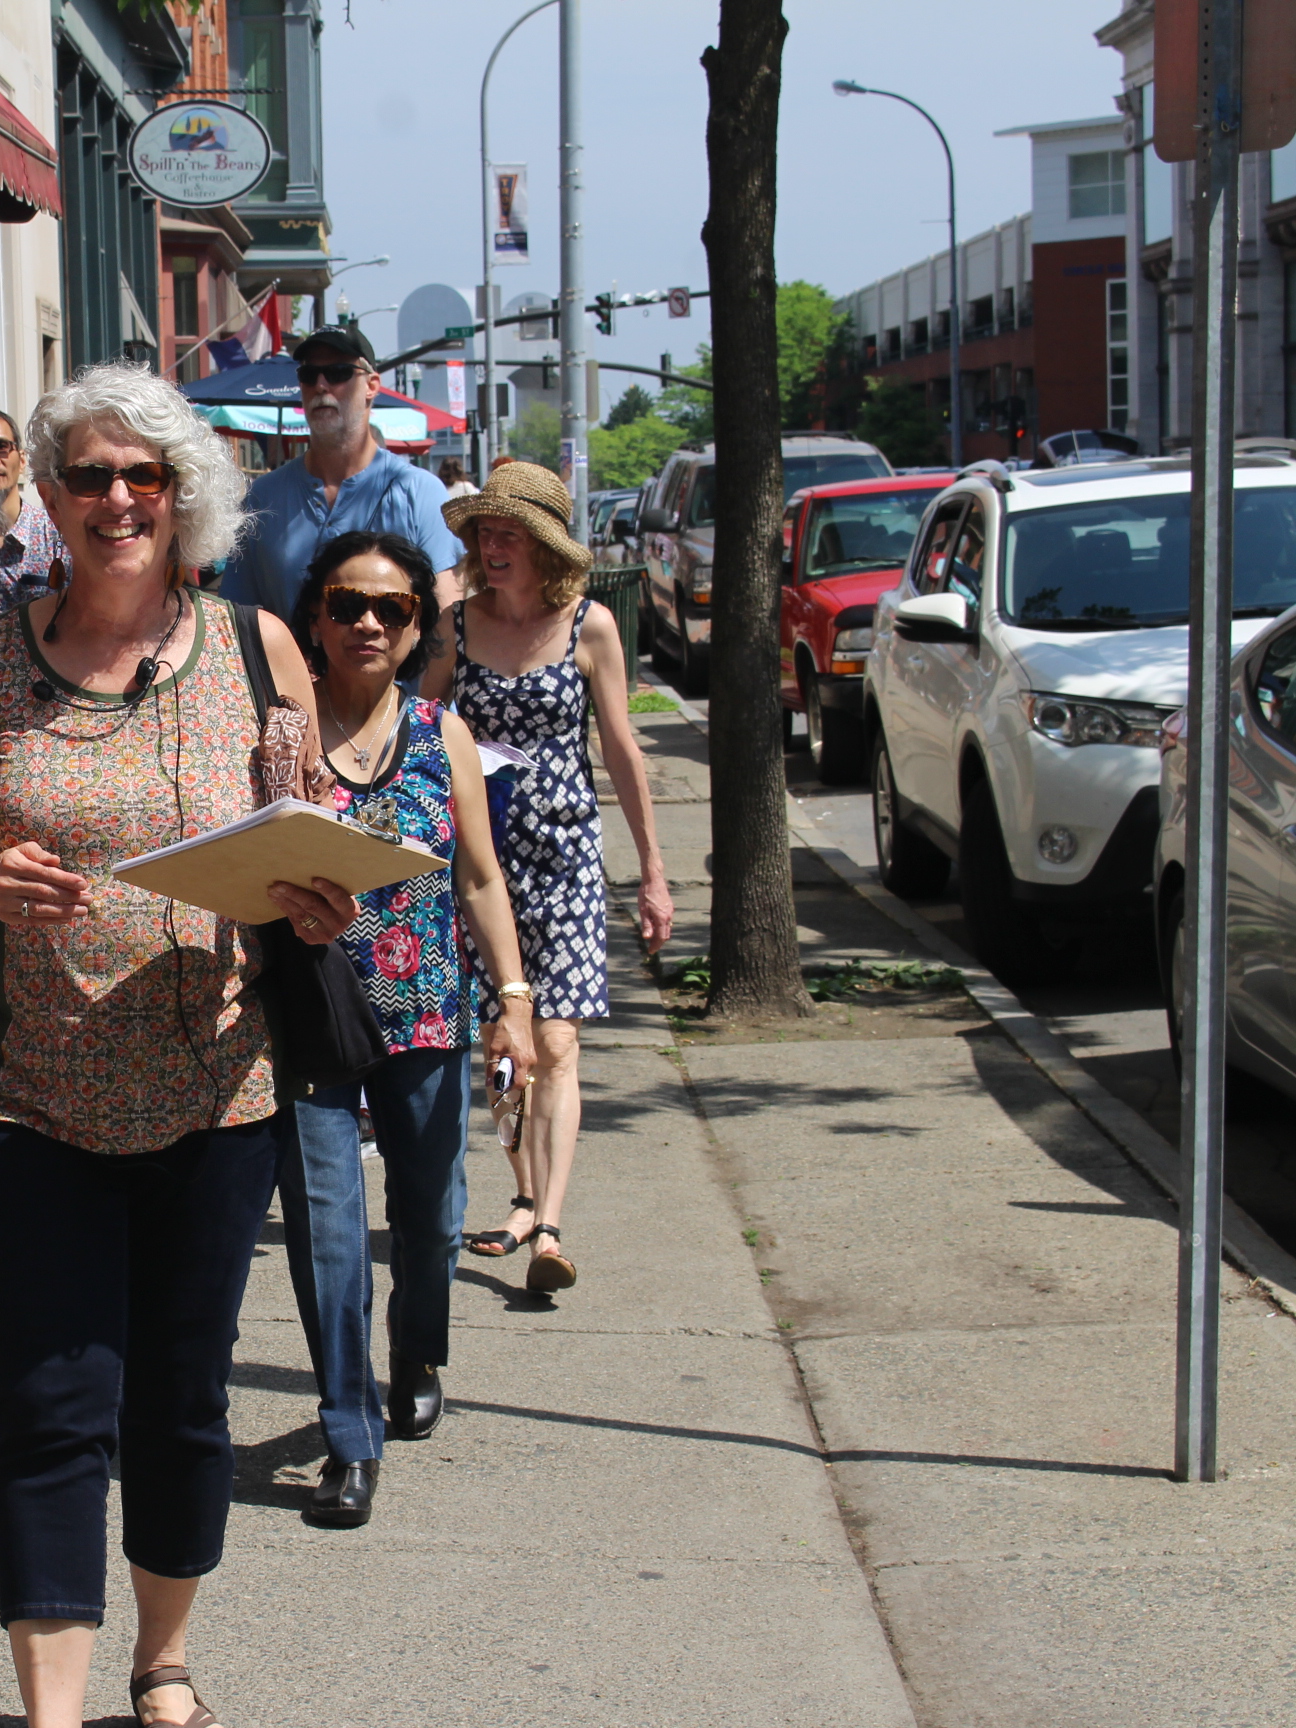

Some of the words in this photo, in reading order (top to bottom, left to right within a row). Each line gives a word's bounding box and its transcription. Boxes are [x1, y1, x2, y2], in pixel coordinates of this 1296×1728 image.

[215, 153, 261, 171] Beans
[164, 172, 234, 184] Coffeehouse
[182, 190, 216, 198] Bistro
[244, 383, 301, 395] Saratog
